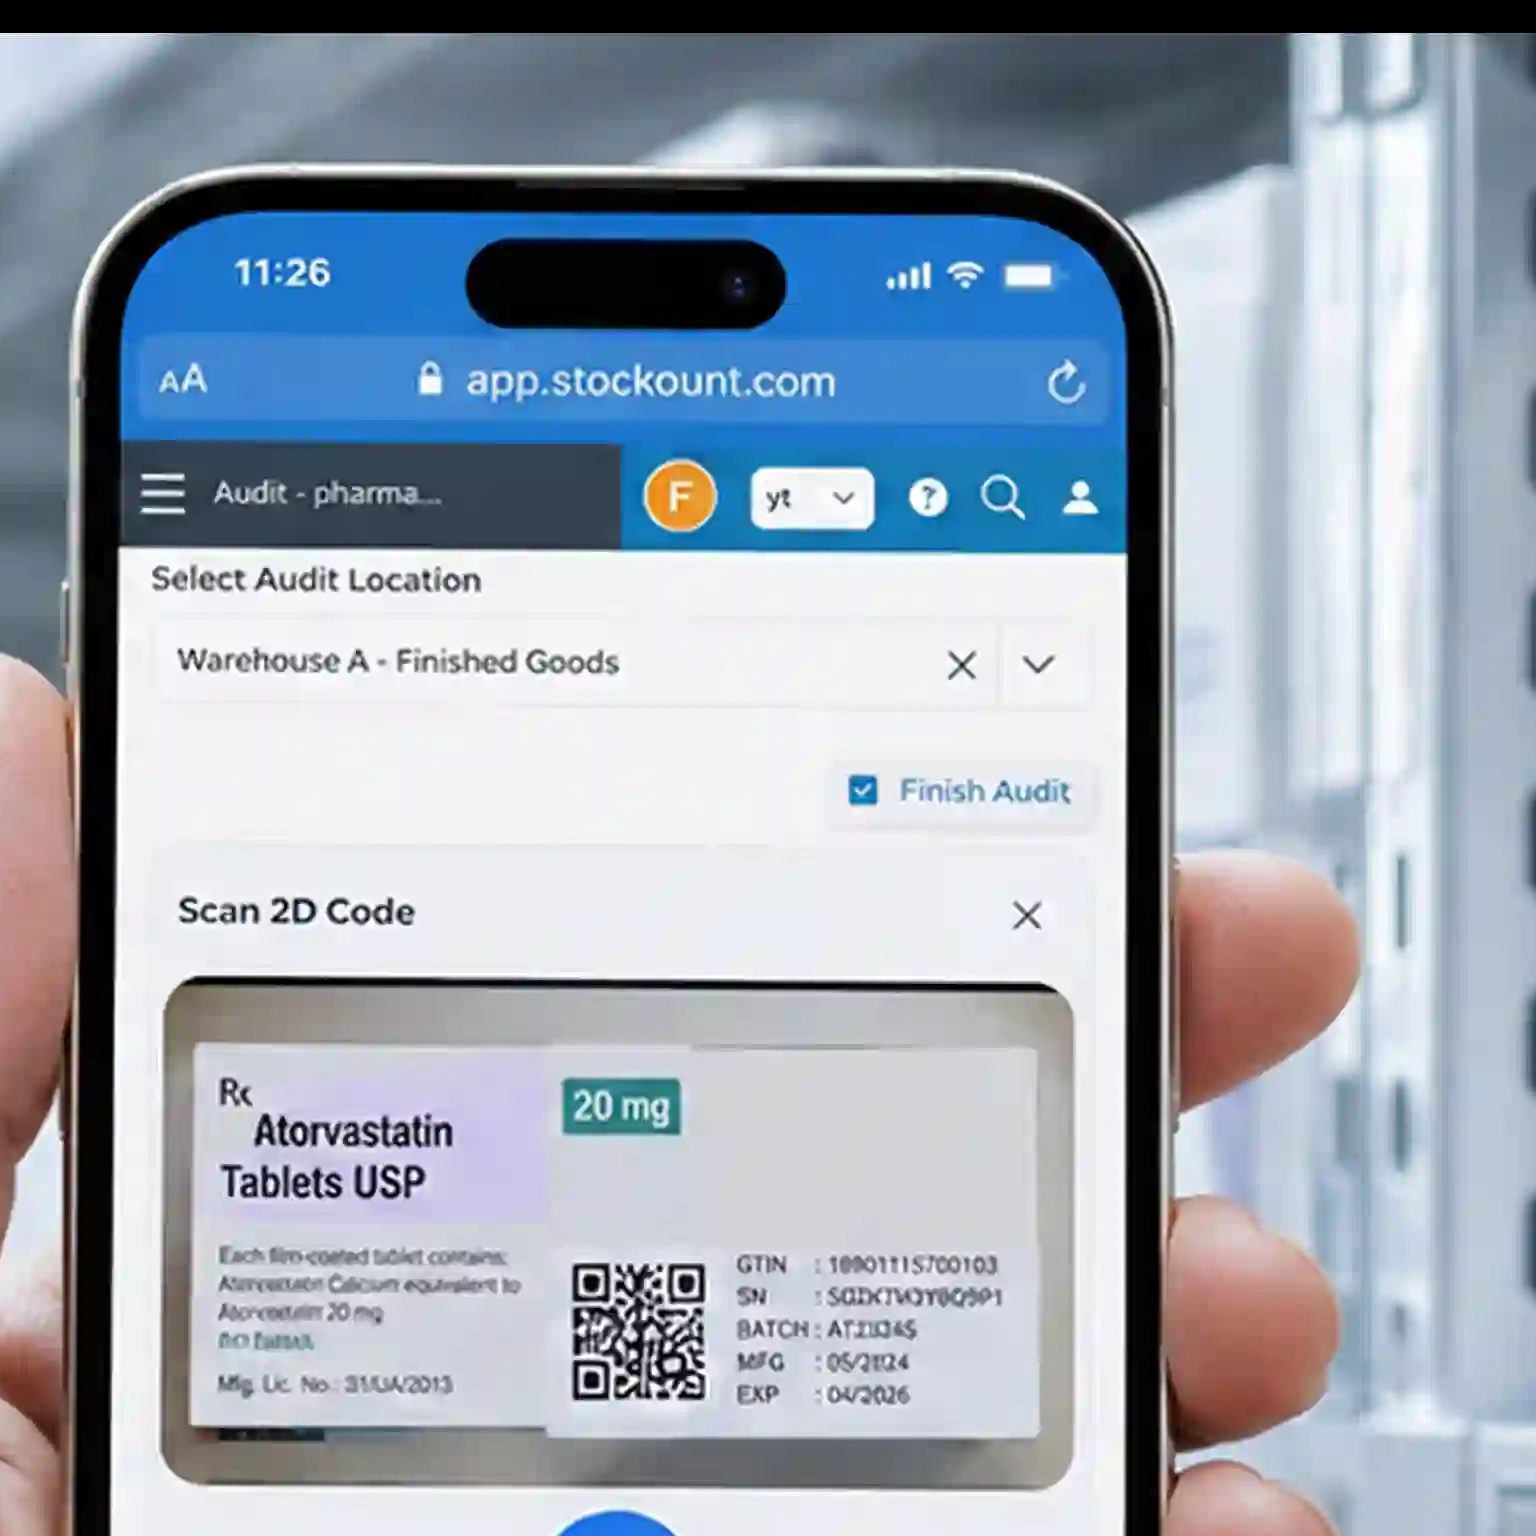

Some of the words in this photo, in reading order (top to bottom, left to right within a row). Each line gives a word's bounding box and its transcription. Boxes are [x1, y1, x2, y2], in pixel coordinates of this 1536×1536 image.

[235, 257, 331, 287] 11:26
[466, 363, 836, 403] app.stockount.com
[213, 479, 288, 505] Audit
[314, 480, 442, 510] pharma...
[669, 479, 693, 513] F
[765, 488, 792, 513] yt
[151, 564, 247, 593] Select
[253, 566, 340, 593] Audit
[348, 565, 482, 594] Location
[176, 647, 342, 674] Warehouse
[346, 648, 370, 674] A
[396, 647, 518, 675] Finished
[525, 648, 621, 676] Goods
[899, 777, 986, 804] Finish
[992, 778, 1071, 805] Audit
[178, 895, 260, 925] Scan
[270, 896, 318, 925] 2D
[325, 897, 416, 927] Code
[573, 1088, 614, 1122] 20
[621, 1096, 670, 1129] mg
[253, 1112, 453, 1149] Atorvastatin
[219, 1163, 343, 1200] Tablets
[354, 1164, 427, 1200] USP
[736, 1254, 787, 1274] GTIN
[736, 1286, 768, 1307] SN
[736, 1318, 810, 1341] BATCH
[736, 1350, 785, 1373] MFG
[736, 1384, 780, 1405] EXP
